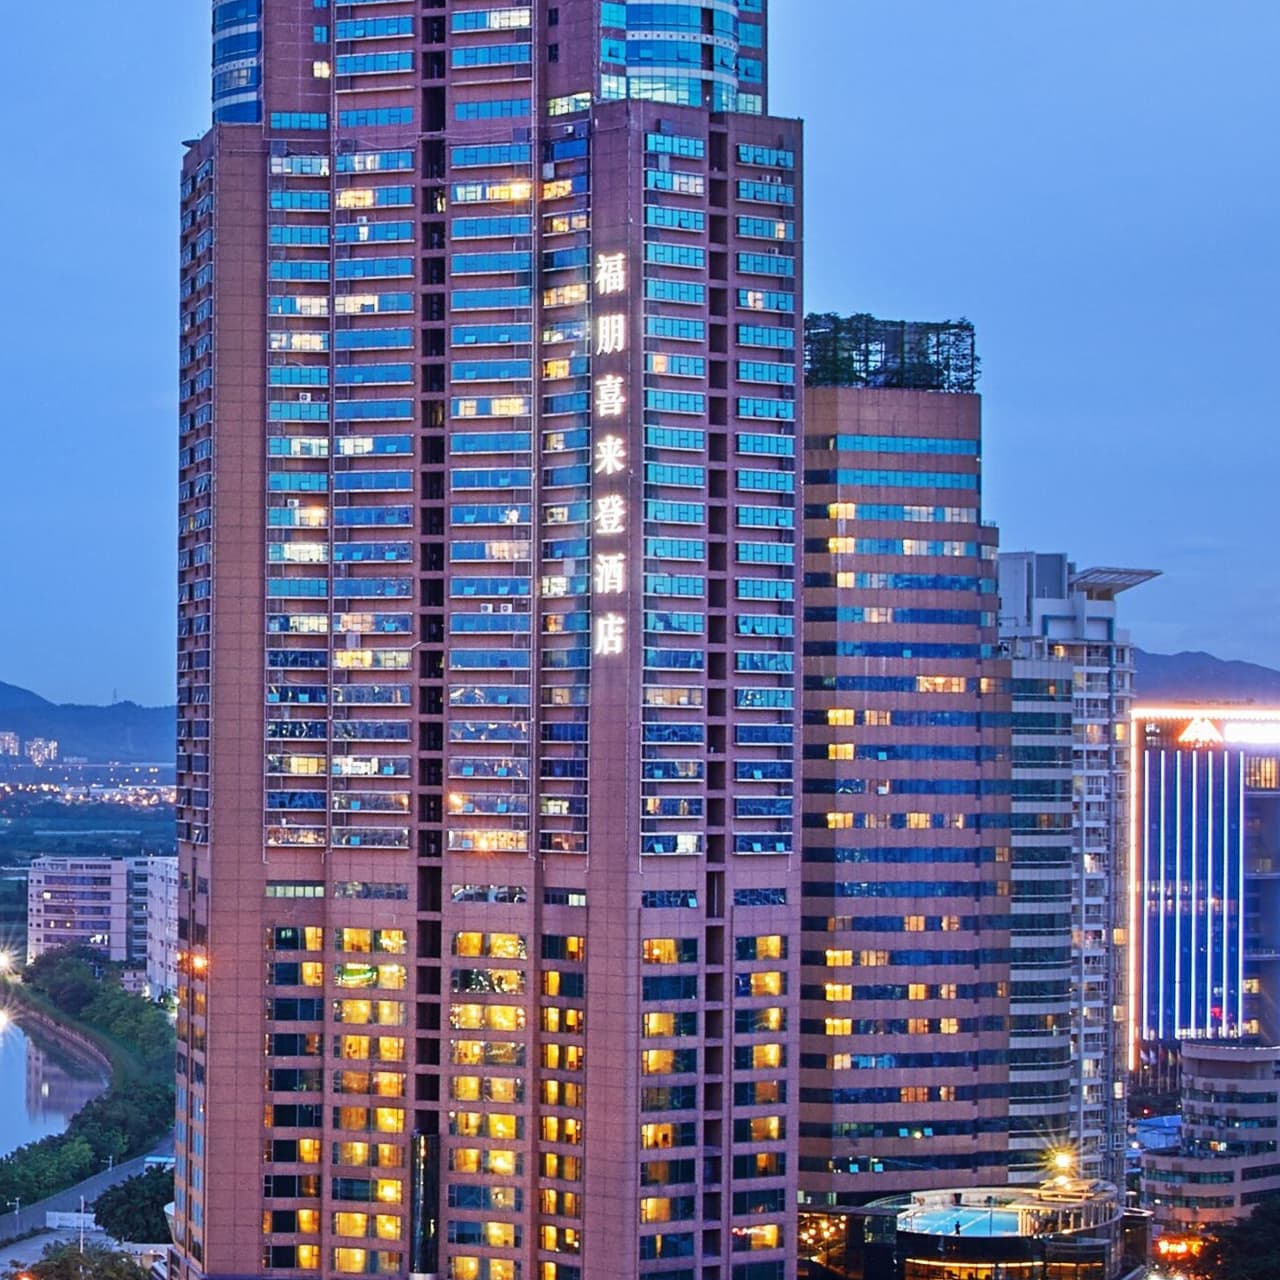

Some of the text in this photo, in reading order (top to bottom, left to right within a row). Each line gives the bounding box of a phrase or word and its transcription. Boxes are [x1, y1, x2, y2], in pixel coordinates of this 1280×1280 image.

[595, 252, 626, 656] 福朋喜来登酒店
